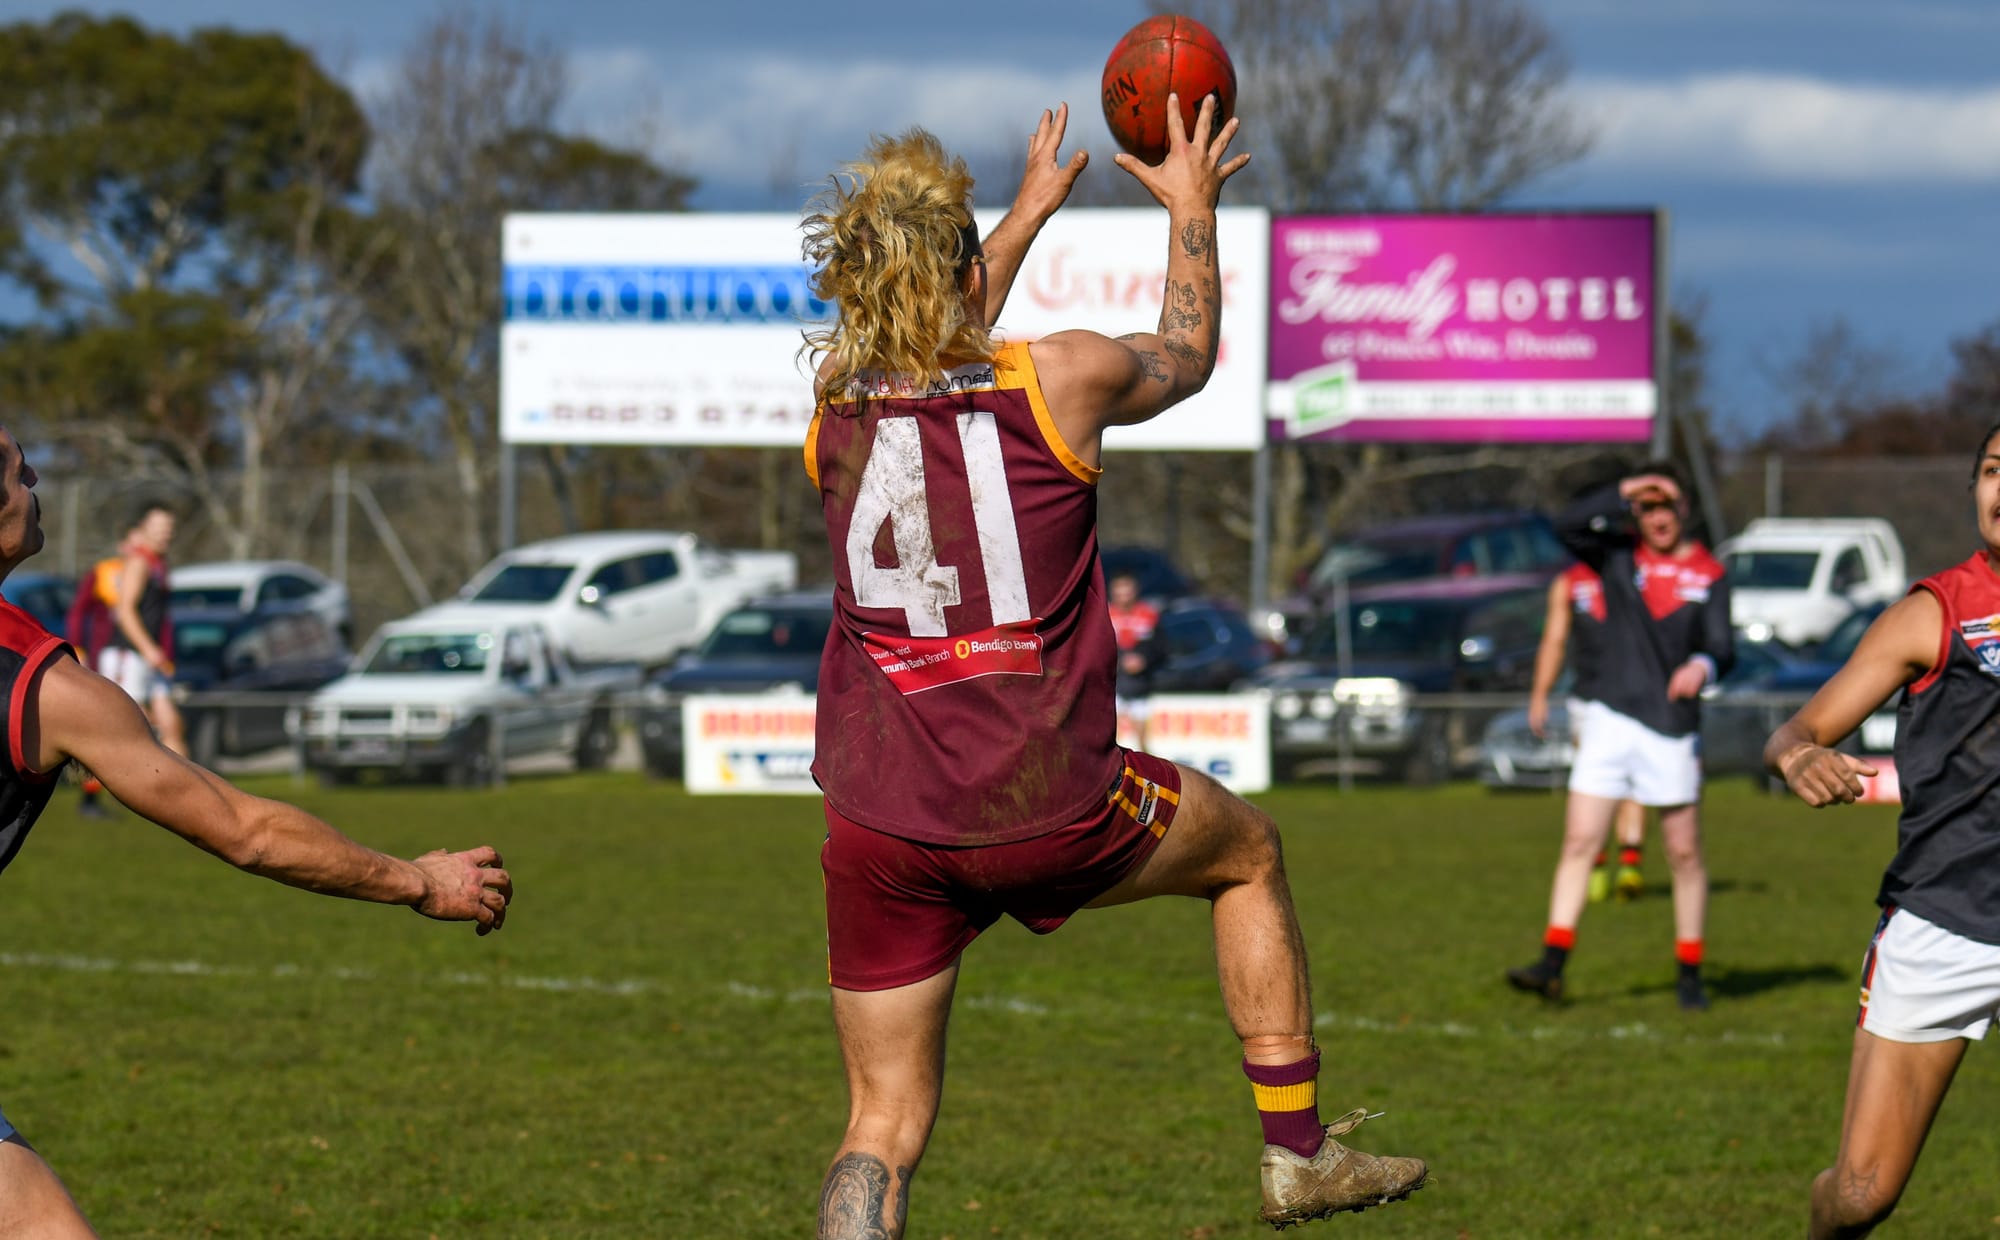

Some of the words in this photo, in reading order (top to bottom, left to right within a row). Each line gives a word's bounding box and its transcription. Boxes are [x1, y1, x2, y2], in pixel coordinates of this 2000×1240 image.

[1278, 252, 1459, 343] Family
[1464, 276, 1645, 322] HOTEL
[846, 411, 1031, 637] 41
[907, 656, 928, 669] Bank
[925, 649, 951, 664] Branch
[970, 638, 1013, 653] Bendigo
[1013, 640, 1038, 651] Bank
